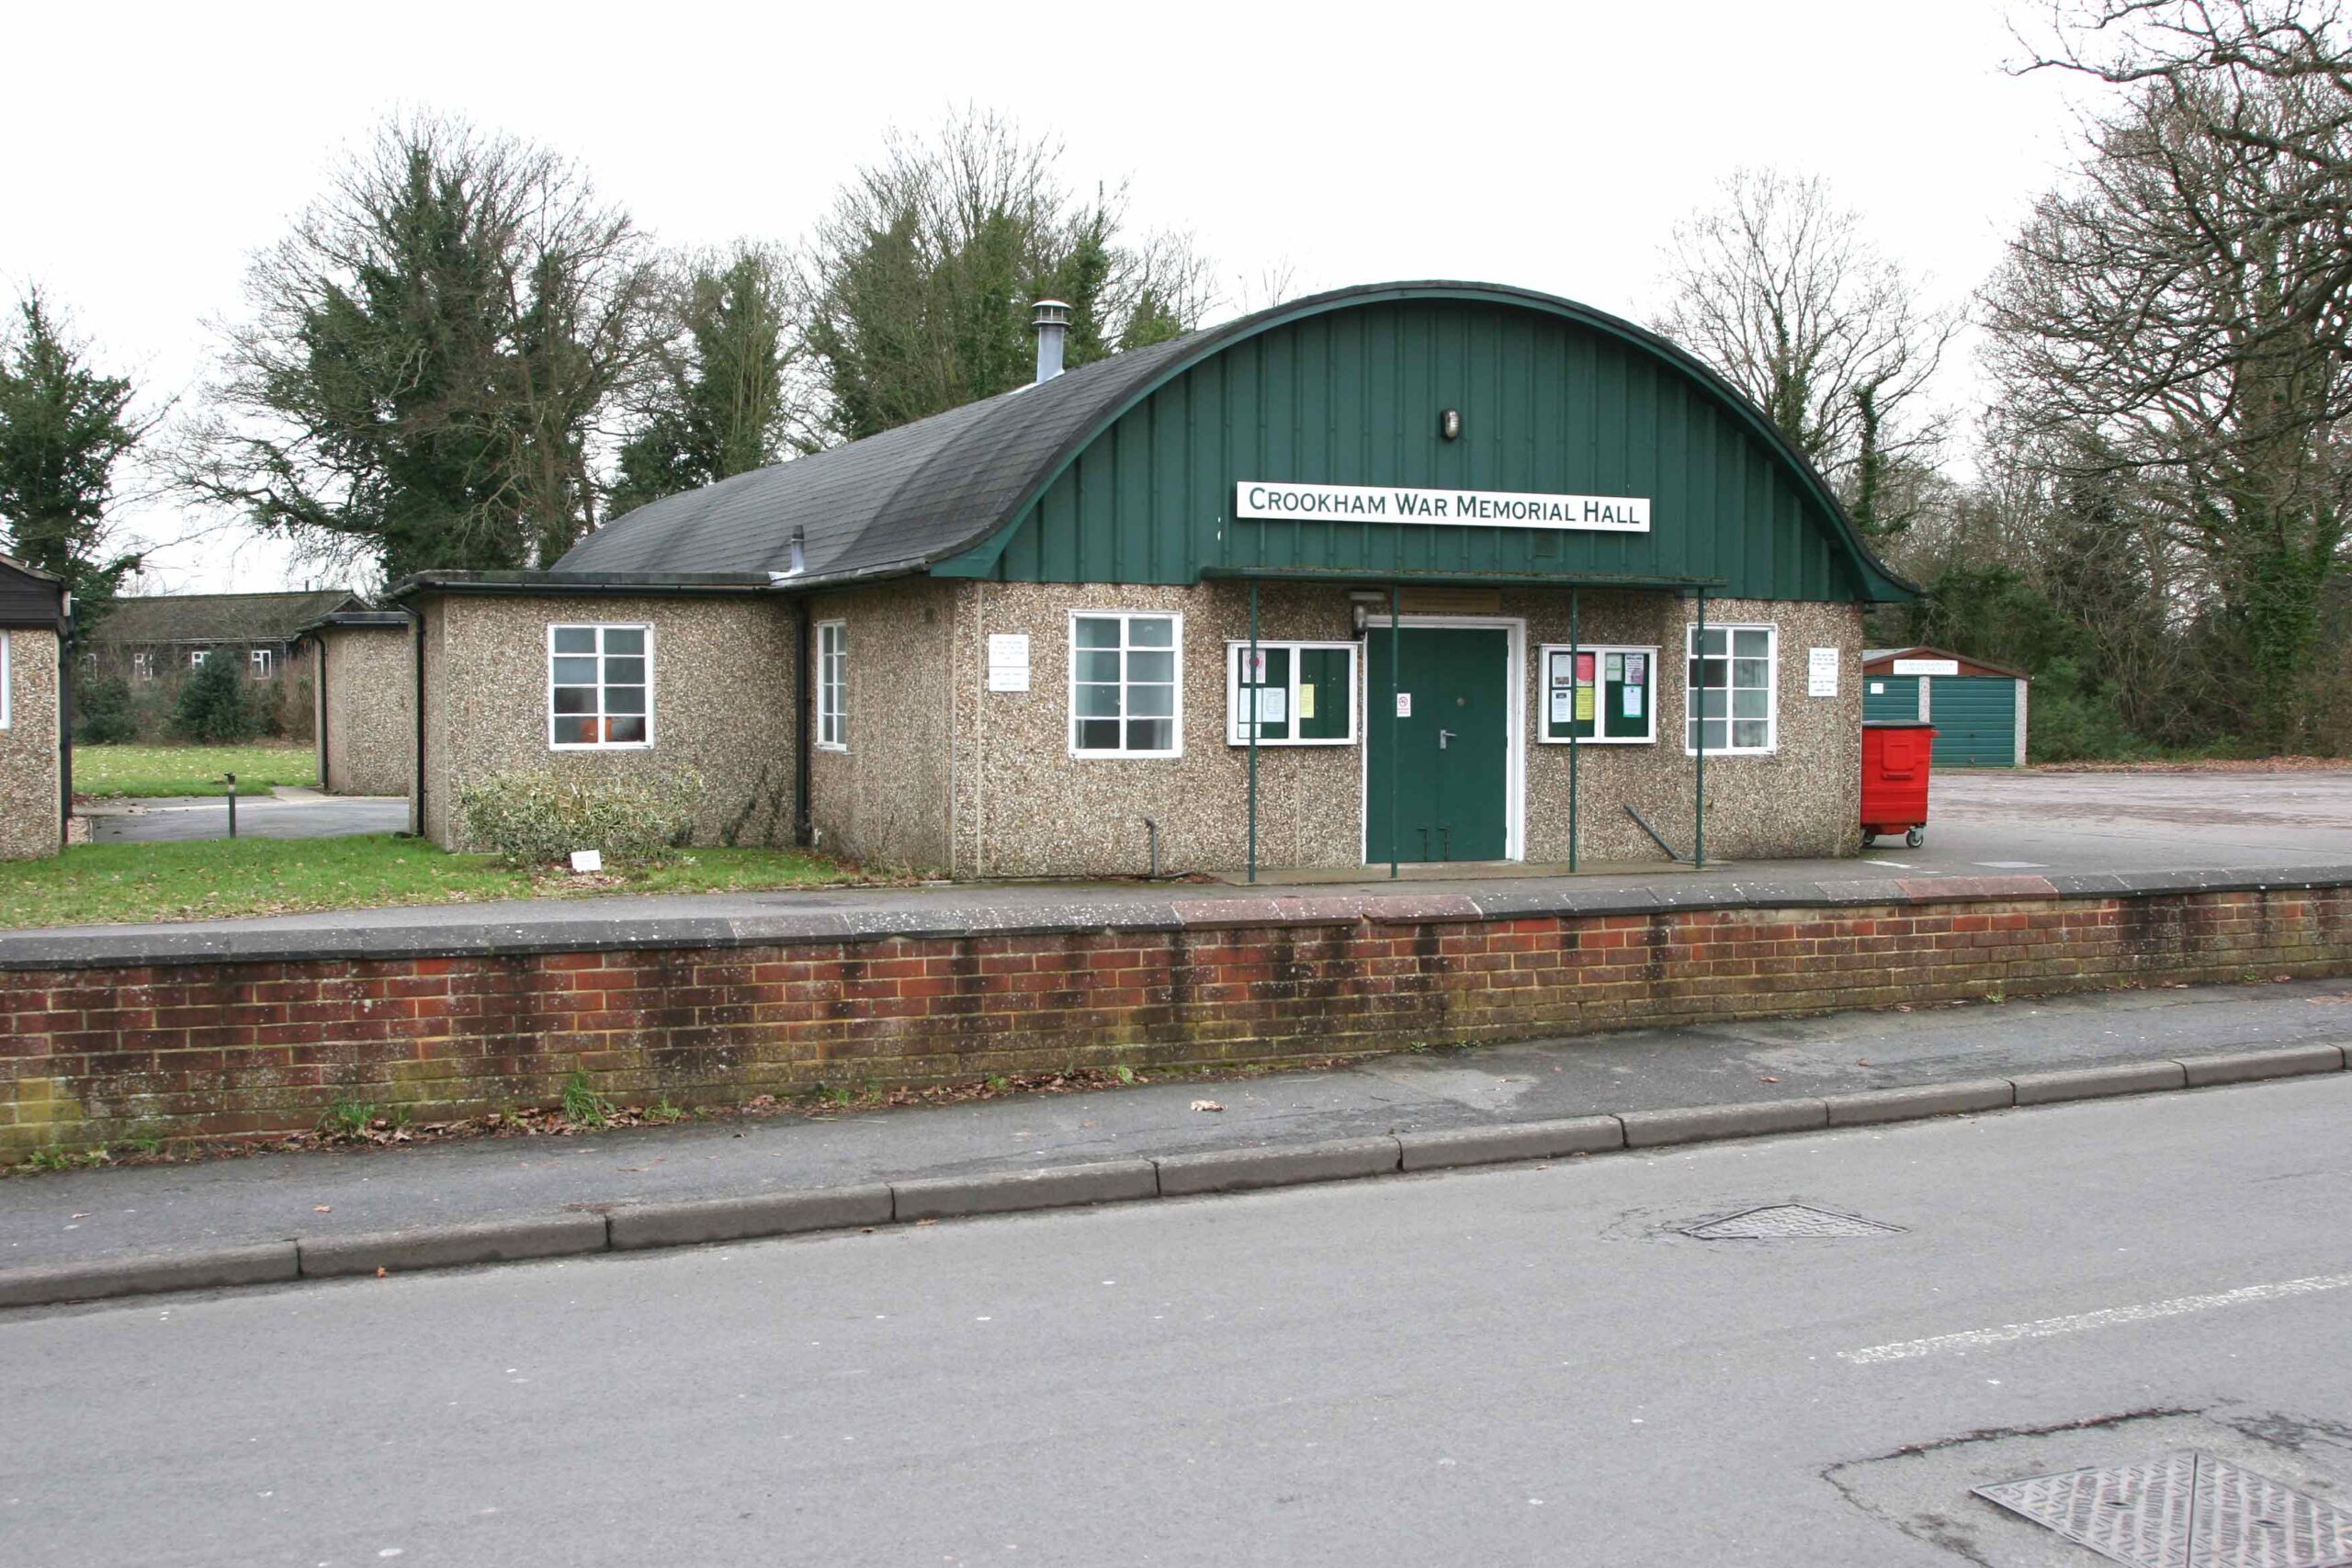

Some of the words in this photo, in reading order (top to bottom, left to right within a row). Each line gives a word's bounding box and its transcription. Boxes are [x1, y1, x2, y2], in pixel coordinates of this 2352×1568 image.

[1249, 487, 1385, 514] CROOKHAM
[1395, 492, 1448, 517] WAR
[1456, 495, 1577, 522] MEMORIAL
[1584, 501, 1640, 525] HALL
